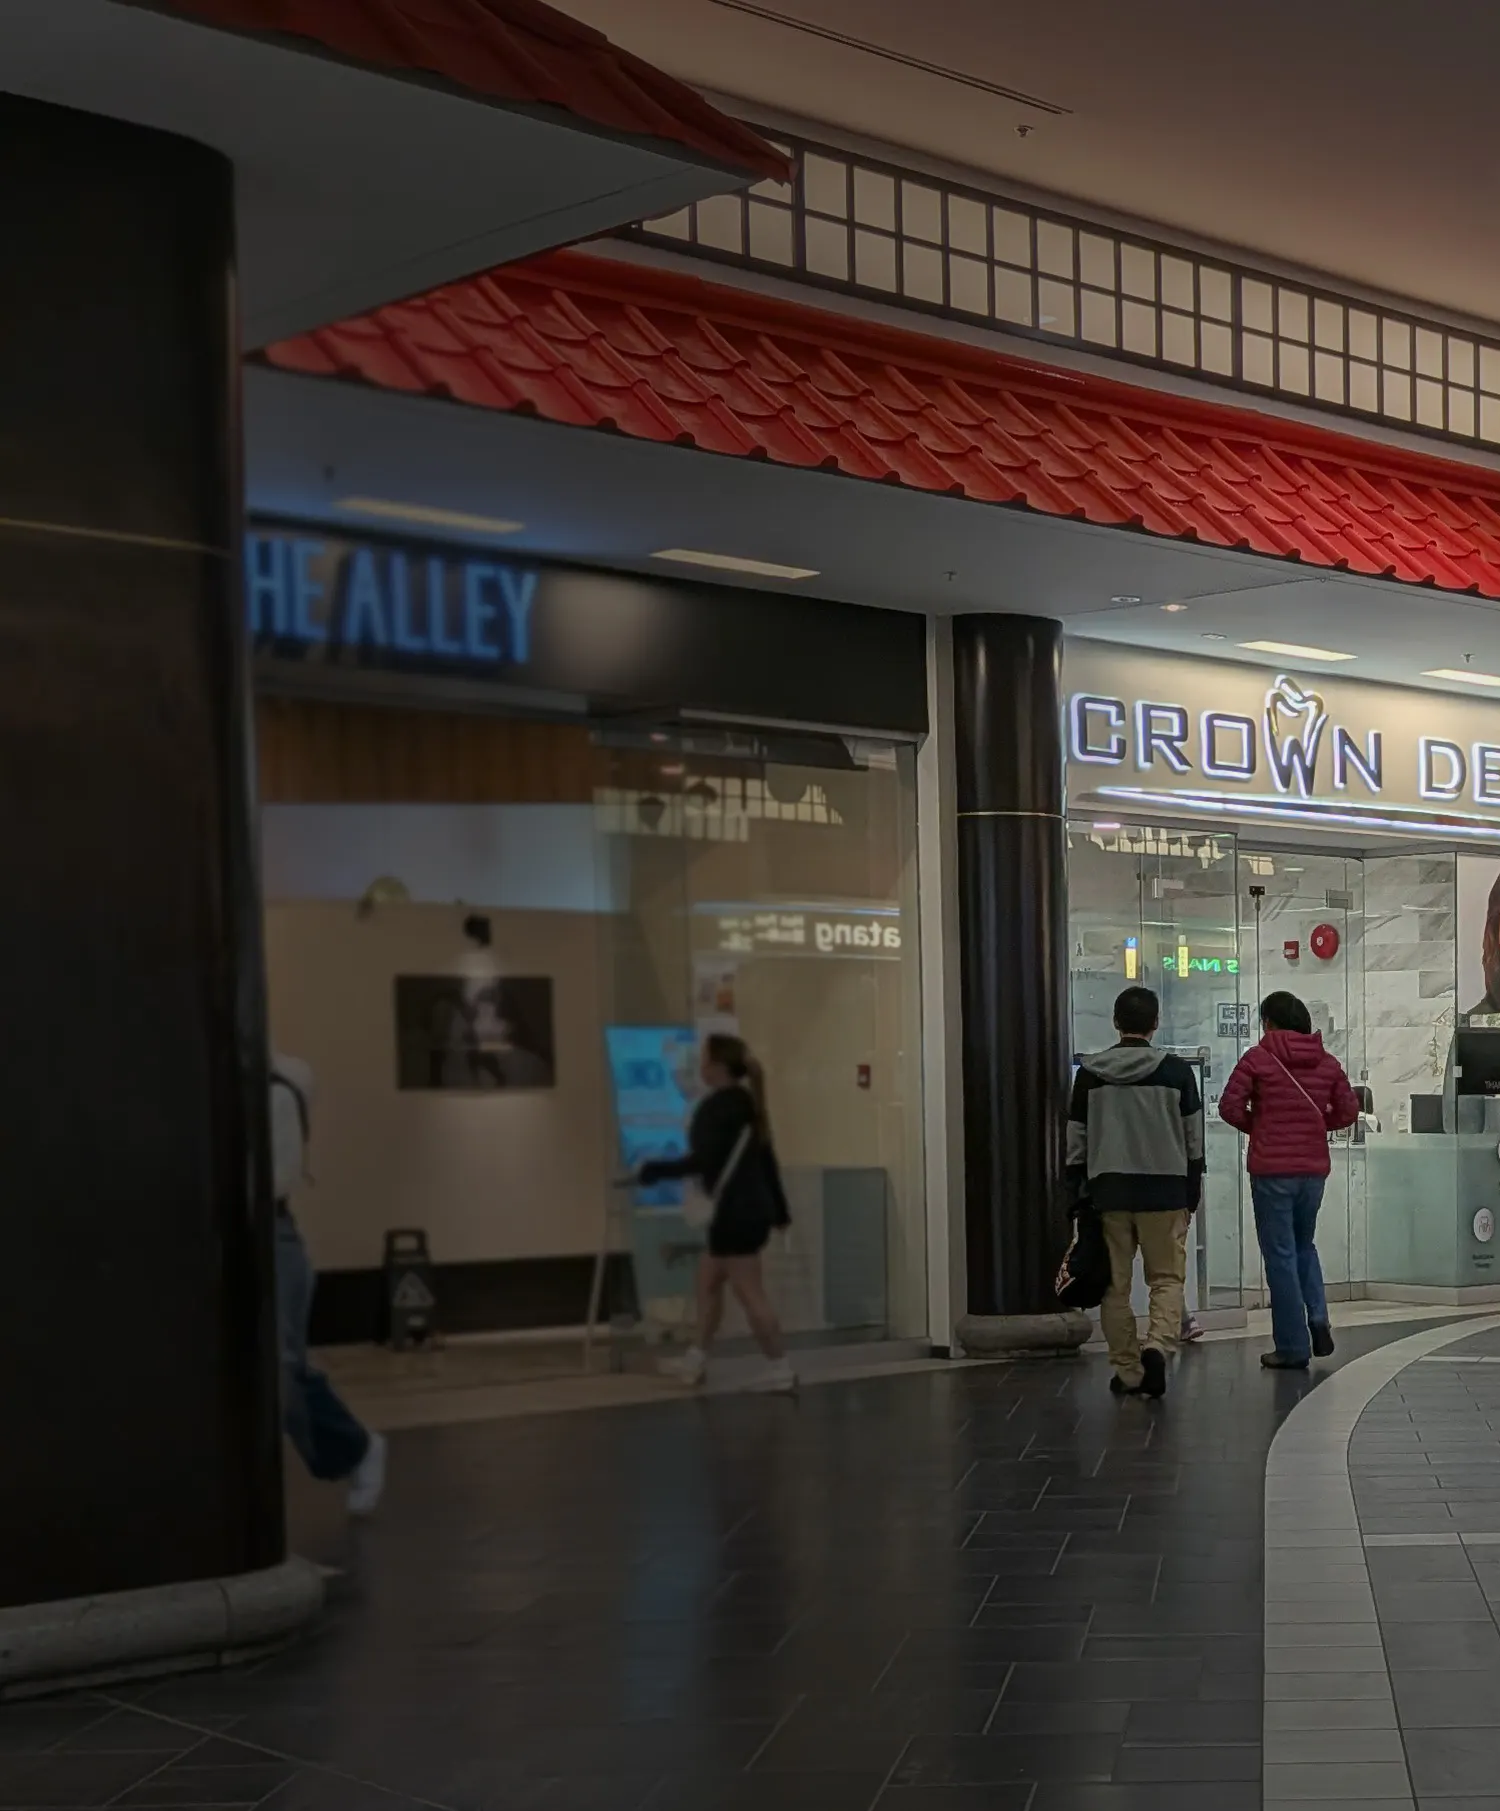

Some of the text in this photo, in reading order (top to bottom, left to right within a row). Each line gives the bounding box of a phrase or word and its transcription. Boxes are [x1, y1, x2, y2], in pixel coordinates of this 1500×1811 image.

[245, 531, 539, 665] HE ALLEY
[1071, 674, 1383, 799] CROWN
